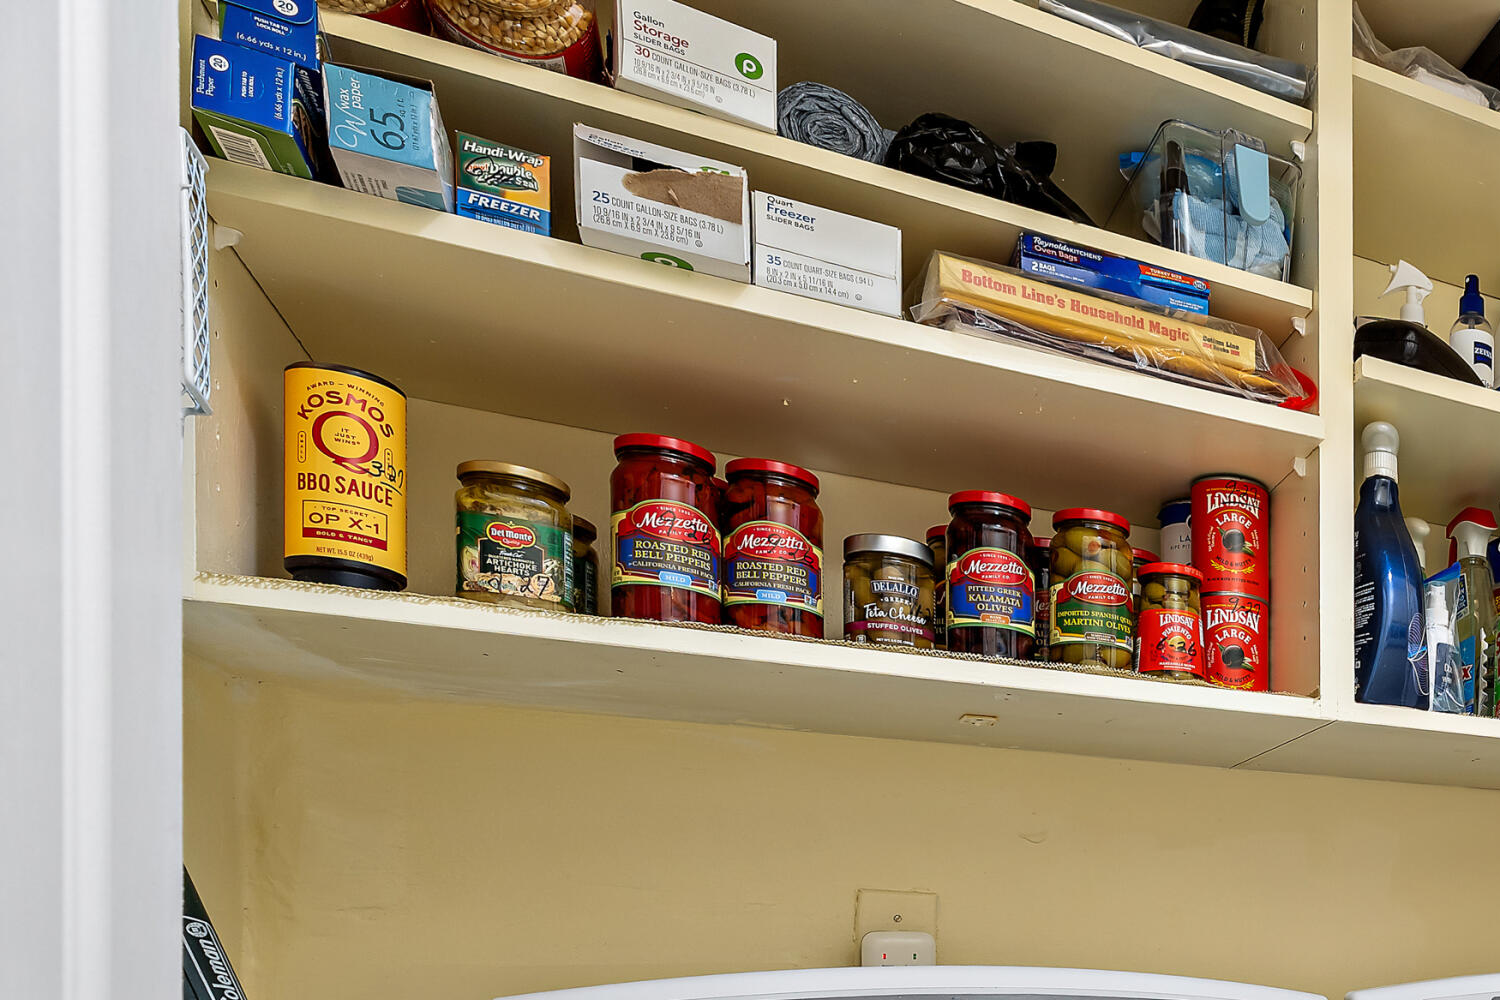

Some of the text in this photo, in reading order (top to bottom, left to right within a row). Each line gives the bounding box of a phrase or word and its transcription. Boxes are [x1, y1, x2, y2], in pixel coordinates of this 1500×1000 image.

[633, 11, 665, 28] Gallon
[633, 20, 689, 48] Storage
[633, 32, 686, 56] SLIDER BAGS
[634, 45, 672, 67] 30 COUNT
[340, 88, 350, 110] wax
[351, 77, 364, 110] paper
[369, 108, 406, 151] 65
[464, 140, 544, 167] Handi-Wrap
[468, 193, 541, 221] FREEZER
[767, 195, 794, 208] Quart
[592, 191, 716, 232] 25 COUNT GALLON-SIZE BAGS (3.78
[767, 203, 816, 224] Freezer
[766, 214, 815, 232] SLIDER BAGS
[1034, 244, 1078, 263] Oven Bags
[766, 254, 837, 279] 35 QUART-SIZE
[961, 269, 1017, 296] Bottom
[1022, 284, 1066, 310] Line's
[1070, 298, 1145, 330] Household
[1149, 319, 1190, 343] Magic
[306, 380, 384, 407] AWARD WINNING
[297, 390, 394, 438] KOSMOS
[312, 410, 379, 475] Q
[297, 472, 393, 507] BBQ SAUCE
[309, 512, 379, 535] OP X-1
[636, 512, 709, 534] Mezzetta
[1215, 512, 1253, 529] LARGE
[348, 534, 373, 544] TANGY
[491, 527, 533, 542] Del Monte
[737, 534, 805, 551] Mezzetta
[635, 541, 711, 561] ROASTED RED
[486, 558, 538, 572] ARTICHOKE
[632, 560, 700, 576] CALIFORNIA FRESH
[634, 550, 711, 572] BELL PEPPERS
[736, 562, 807, 578] ROASTED RED
[964, 560, 1024, 576] Mezzetta
[494, 564, 530, 577] HEARTS
[736, 571, 807, 587] BELL PEPPERS
[873, 582, 918, 598] DELALLO
[968, 585, 1022, 598] PITTED GREEK
[1071, 581, 1127, 597] Mezzetta
[968, 593, 1021, 607] KALAMATA
[976, 603, 1014, 614] OLIVES
[863, 602, 927, 626] Feta Cheese
[1057, 610, 1119, 621] IMPORTED SPANISH
[867, 622, 924, 636] STUFFED OLIVES
[1063, 618, 1132, 635] MARTINI OLIVES
[1162, 625, 1192, 640] PIMIENTO
[1215, 628, 1252, 645] LARGE
